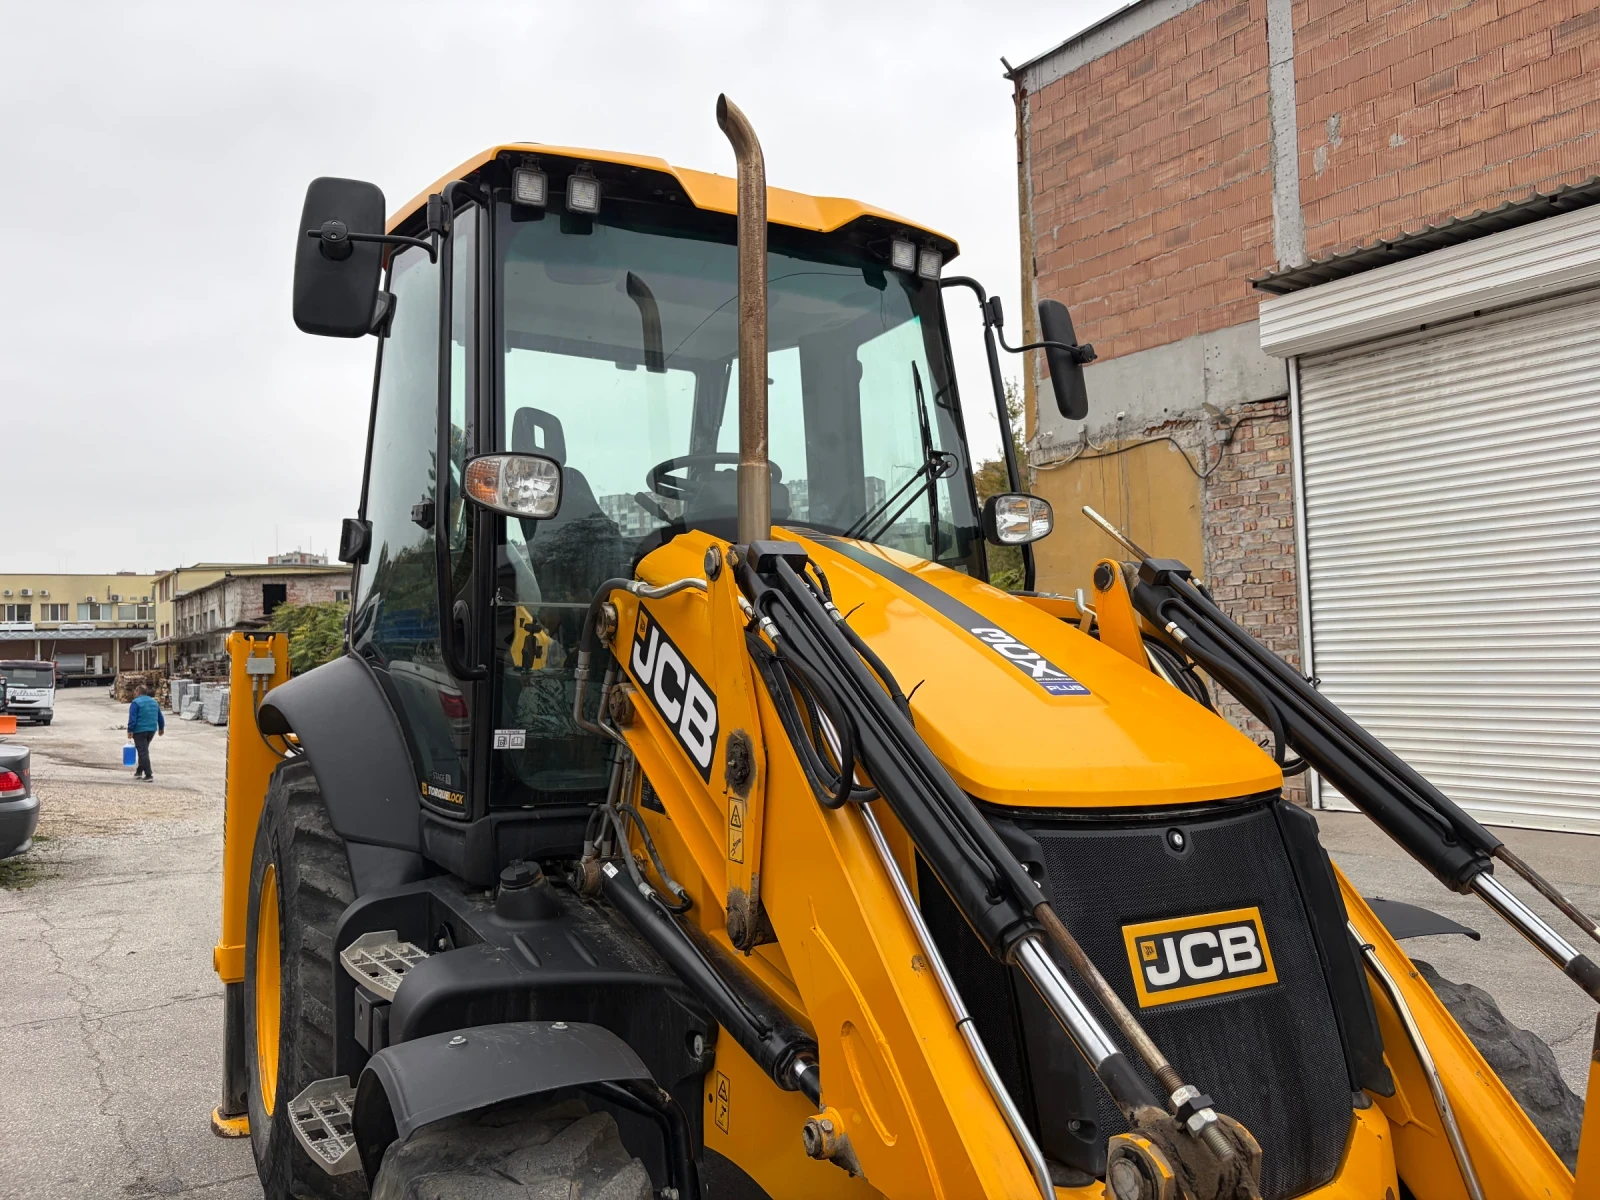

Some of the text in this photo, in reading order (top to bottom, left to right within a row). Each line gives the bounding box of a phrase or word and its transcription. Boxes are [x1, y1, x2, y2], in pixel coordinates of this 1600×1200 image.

[970, 628, 1068, 677] 3CX
[632, 625, 717, 768] JCB
[1145, 926, 1262, 986] JCB
